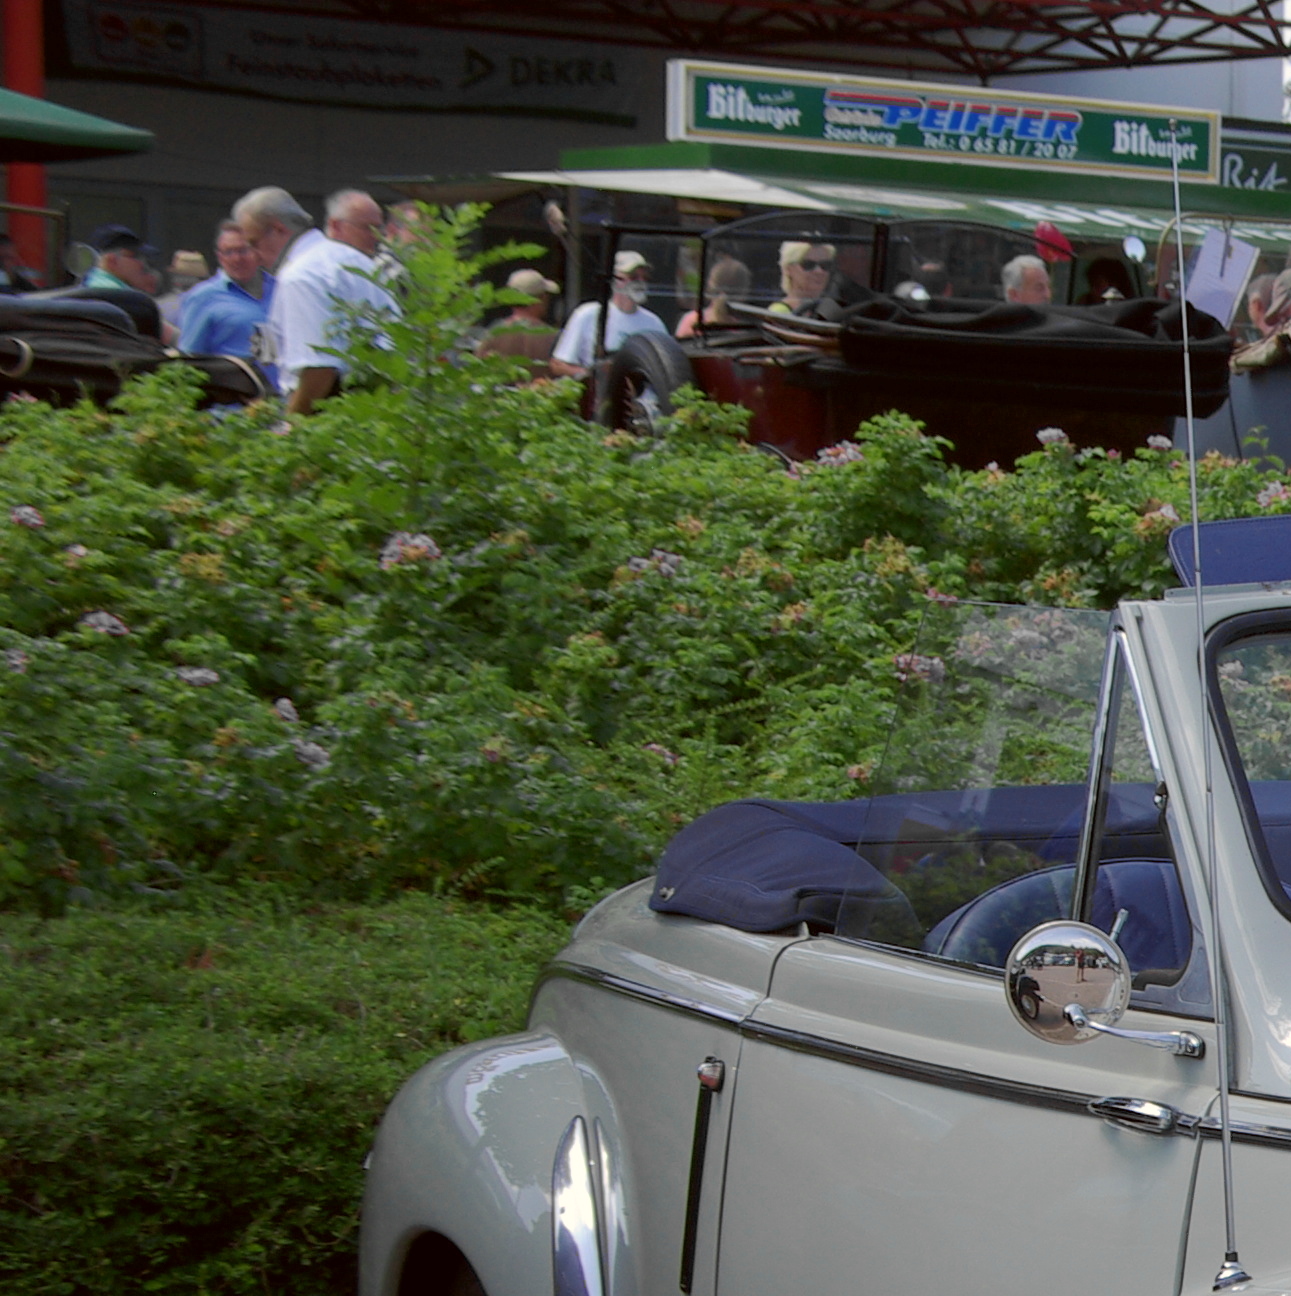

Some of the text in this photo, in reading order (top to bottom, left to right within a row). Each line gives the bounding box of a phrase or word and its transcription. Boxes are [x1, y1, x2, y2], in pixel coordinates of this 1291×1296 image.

[510, 56, 618, 88] DEKRA
[706, 82, 802, 131] Bitburger
[823, 91, 1082, 143] PEIFFER
[823, 123, 897, 148] Saarburg
[958, 134, 971, 151] 0
[974, 136, 995, 154] 65
[996, 138, 1017, 156] 81
[1034, 141, 1055, 159] 20
[1057, 143, 1078, 160] 07
[1112, 119, 1199, 162] Bitburger
